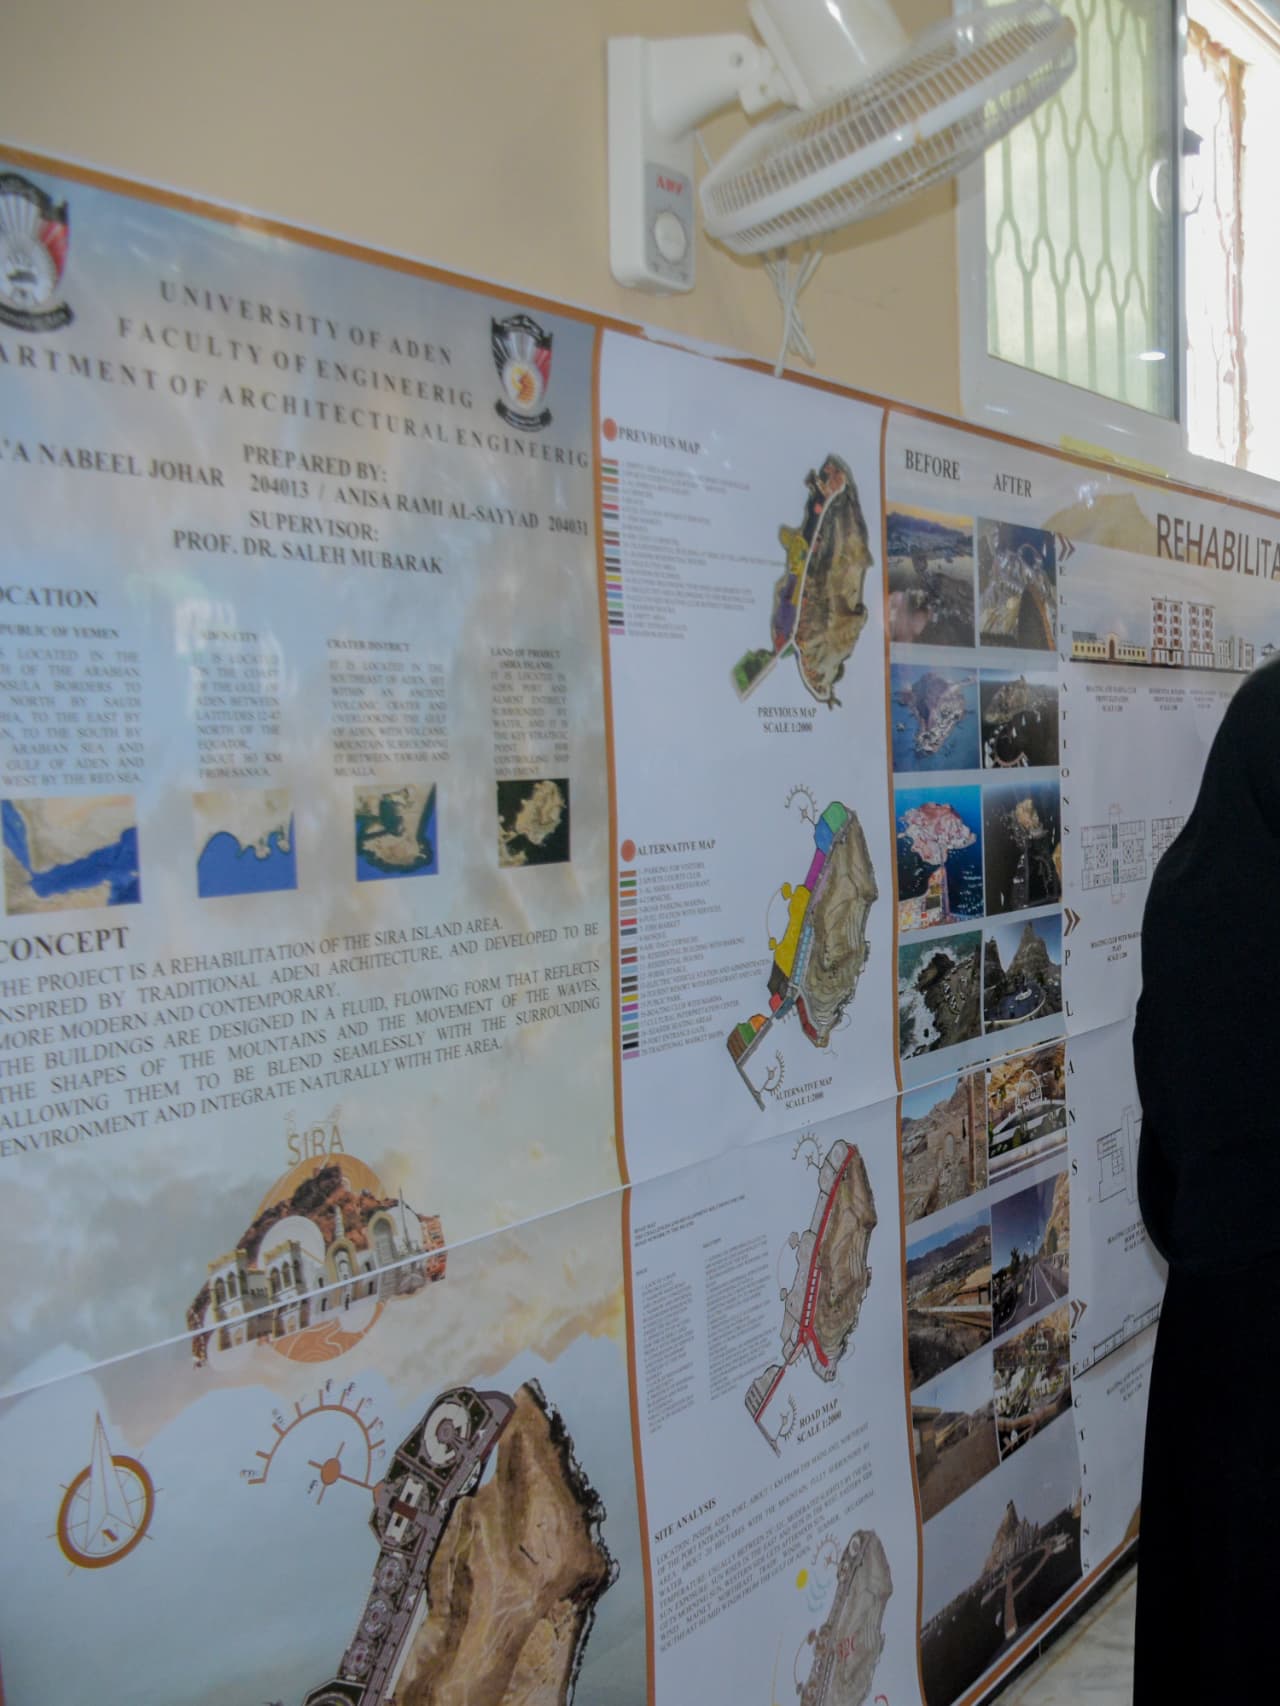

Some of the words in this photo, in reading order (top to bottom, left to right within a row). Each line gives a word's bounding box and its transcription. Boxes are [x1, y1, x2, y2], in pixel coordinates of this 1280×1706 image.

[160, 280, 338, 340] UNIVERSITY
[349, 328, 380, 349] OF
[391, 338, 452, 365] ADEN
[117, 317, 262, 365] FACULTY
[273, 351, 307, 374] OF
[317, 358, 473, 410] ENGINEERIG
[169, 375, 208, 400] OF
[219, 385, 449, 443] ARCHITECTURAL
[456, 427, 589, 469] ENGINEERIG
[618, 426, 676, 450] PREVIOUS
[677, 440, 701, 455] MAP
[0, 438, 31, 464] 'A
[38, 443, 142, 477] NABEEL
[148, 458, 225, 487] JOHAR
[249, 473, 309, 499] 204013
[335, 486, 392, 512] ANISA
[396, 494, 444, 518] RAMI
[451, 499, 539, 529] AL-SAYYAD
[242, 443, 350, 477] PREPARED
[357, 460, 387, 483] BY:
[905, 449, 960, 481] BEFORE
[993, 473, 1032, 499] AFTER
[249, 509, 379, 542] SUPERVISOR:
[172, 529, 238, 554] PROF.
[243, 537, 277, 559] DR.
[282, 541, 346, 566] SALEH
[351, 549, 443, 575] MUBARAK
[0, 585, 98, 608] CATION
[758, 706, 798, 718] PREVIOUS
[799, 706, 817, 718] MAP
[763, 722, 790, 733] SCALE
[637, 841, 697, 856] ALTERNATIVE
[699, 839, 716, 850] MAP
[38, 966, 125, 992] PROJECT
[130, 964, 146, 980] IS
[152, 962, 166, 977] A
[171, 941, 317, 975] REHABILITATION
[320, 938, 340, 954] OF
[343, 934, 370, 951] THE
[374, 928, 408, 944] SIRA
[412, 921, 462, 941] ISLAND
[100, 991, 125, 1010] BY
[140, 972, 259, 1003] TRADITIONAL
[271, 963, 320, 984] ADENI
[451, 940, 478, 957] AND
[485, 928, 558, 951] DEVELOPED
[564, 925, 579, 938] TO
[585, 922, 599, 936] BE
[45, 1036, 154, 1070] BUILDINGS
[164, 1029, 200, 1049] ARE
[209, 1013, 294, 1041] DESIGNED
[302, 1008, 318, 1024] IN
[326, 1004, 336, 1020] A
[394, 985, 458, 1008] FLOWING
[464, 976, 501, 994] FORM
[506, 970, 538, 986] THAT
[544, 960, 600, 980] REFLECTS
[60, 1013, 148, 1042] MODERN
[153, 1005, 194, 1027] AND
[51, 1065, 127, 1094] SHAPES
[141, 1058, 166, 1078] OF
[179, 1051, 215, 1070] THE
[228, 1030, 327, 1061] MOUNTAINS
[336, 1022, 368, 1040] AND
[378, 1013, 405, 1032] THE
[416, 998, 492, 1025] MOVEMENT
[502, 992, 520, 1008] OF
[527, 988, 549, 1004] THE
[1, 1094, 110, 1131] ALLOWING
[126, 1081, 180, 1104] THEM
[196, 1073, 220, 1091] TO
[234, 1067, 254, 1084] BE
[267, 1052, 322, 1077] BLEND
[333, 1031, 425, 1063] SEAMLESSLY
[437, 1022, 472, 1040] WITH
[482, 1016, 506, 1032] THE
[515, 997, 600, 1026] SURROUNDING
[1, 1111, 149, 1157] ENVIRONMENT
[154, 1102, 196, 1124] AND
[202, 1079, 296, 1114] INTEGRATE
[300, 1057, 390, 1092] NATURALLY
[394, 1052, 432, 1071] WITH
[436, 1046, 460, 1064] THE
[775, 1080, 815, 1101] ALTERNATIVE
[816, 1076, 833, 1091] MAP
[287, 1124, 345, 1166] SIRA
[797, 1422, 822, 1444] SCALE
[799, 1408, 821, 1429] ROAD
[821, 1398, 838, 1415] MAP
[655, 1525, 672, 1543] SITE
[677, 1498, 716, 1528] ANALYSIS
